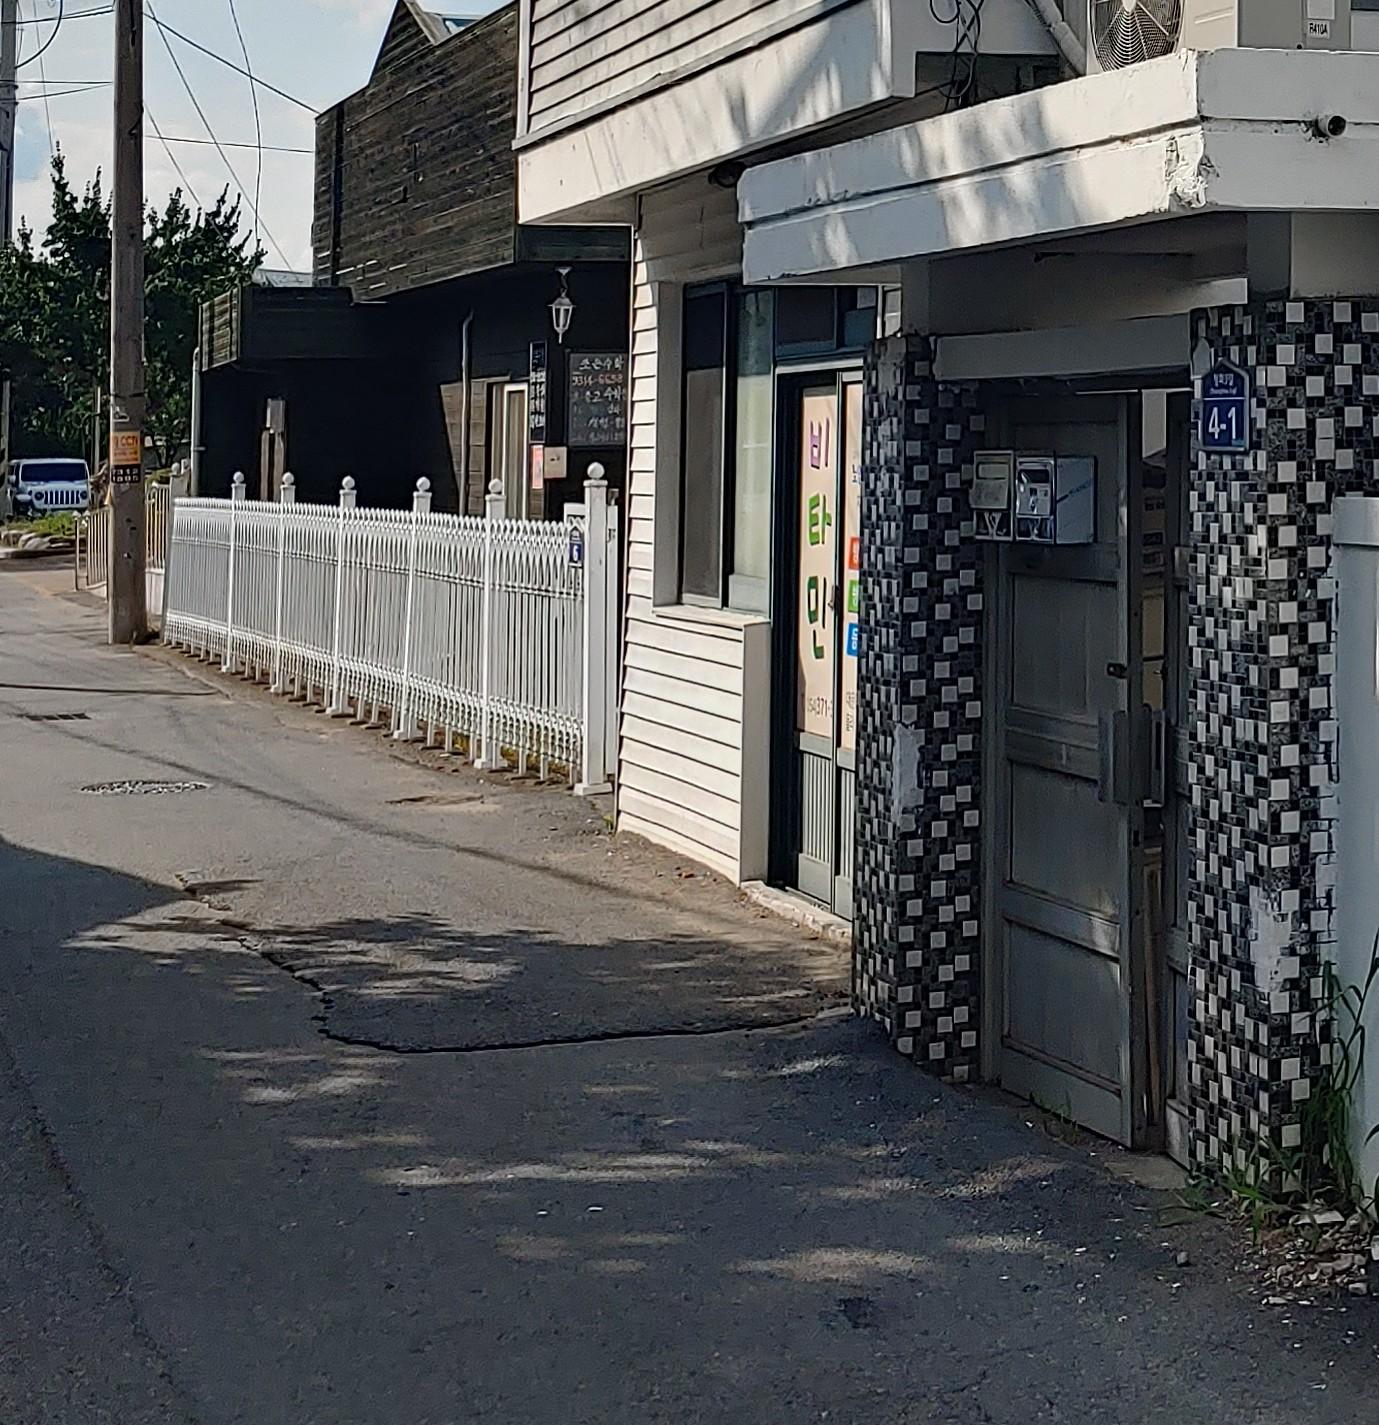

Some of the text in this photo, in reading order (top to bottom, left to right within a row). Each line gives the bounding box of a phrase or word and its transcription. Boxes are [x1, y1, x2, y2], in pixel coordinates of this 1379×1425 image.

[1208, 406, 1236, 440] 4-1
[573, 544, 579, 562] 6
[808, 416, 832, 660] 비타민
